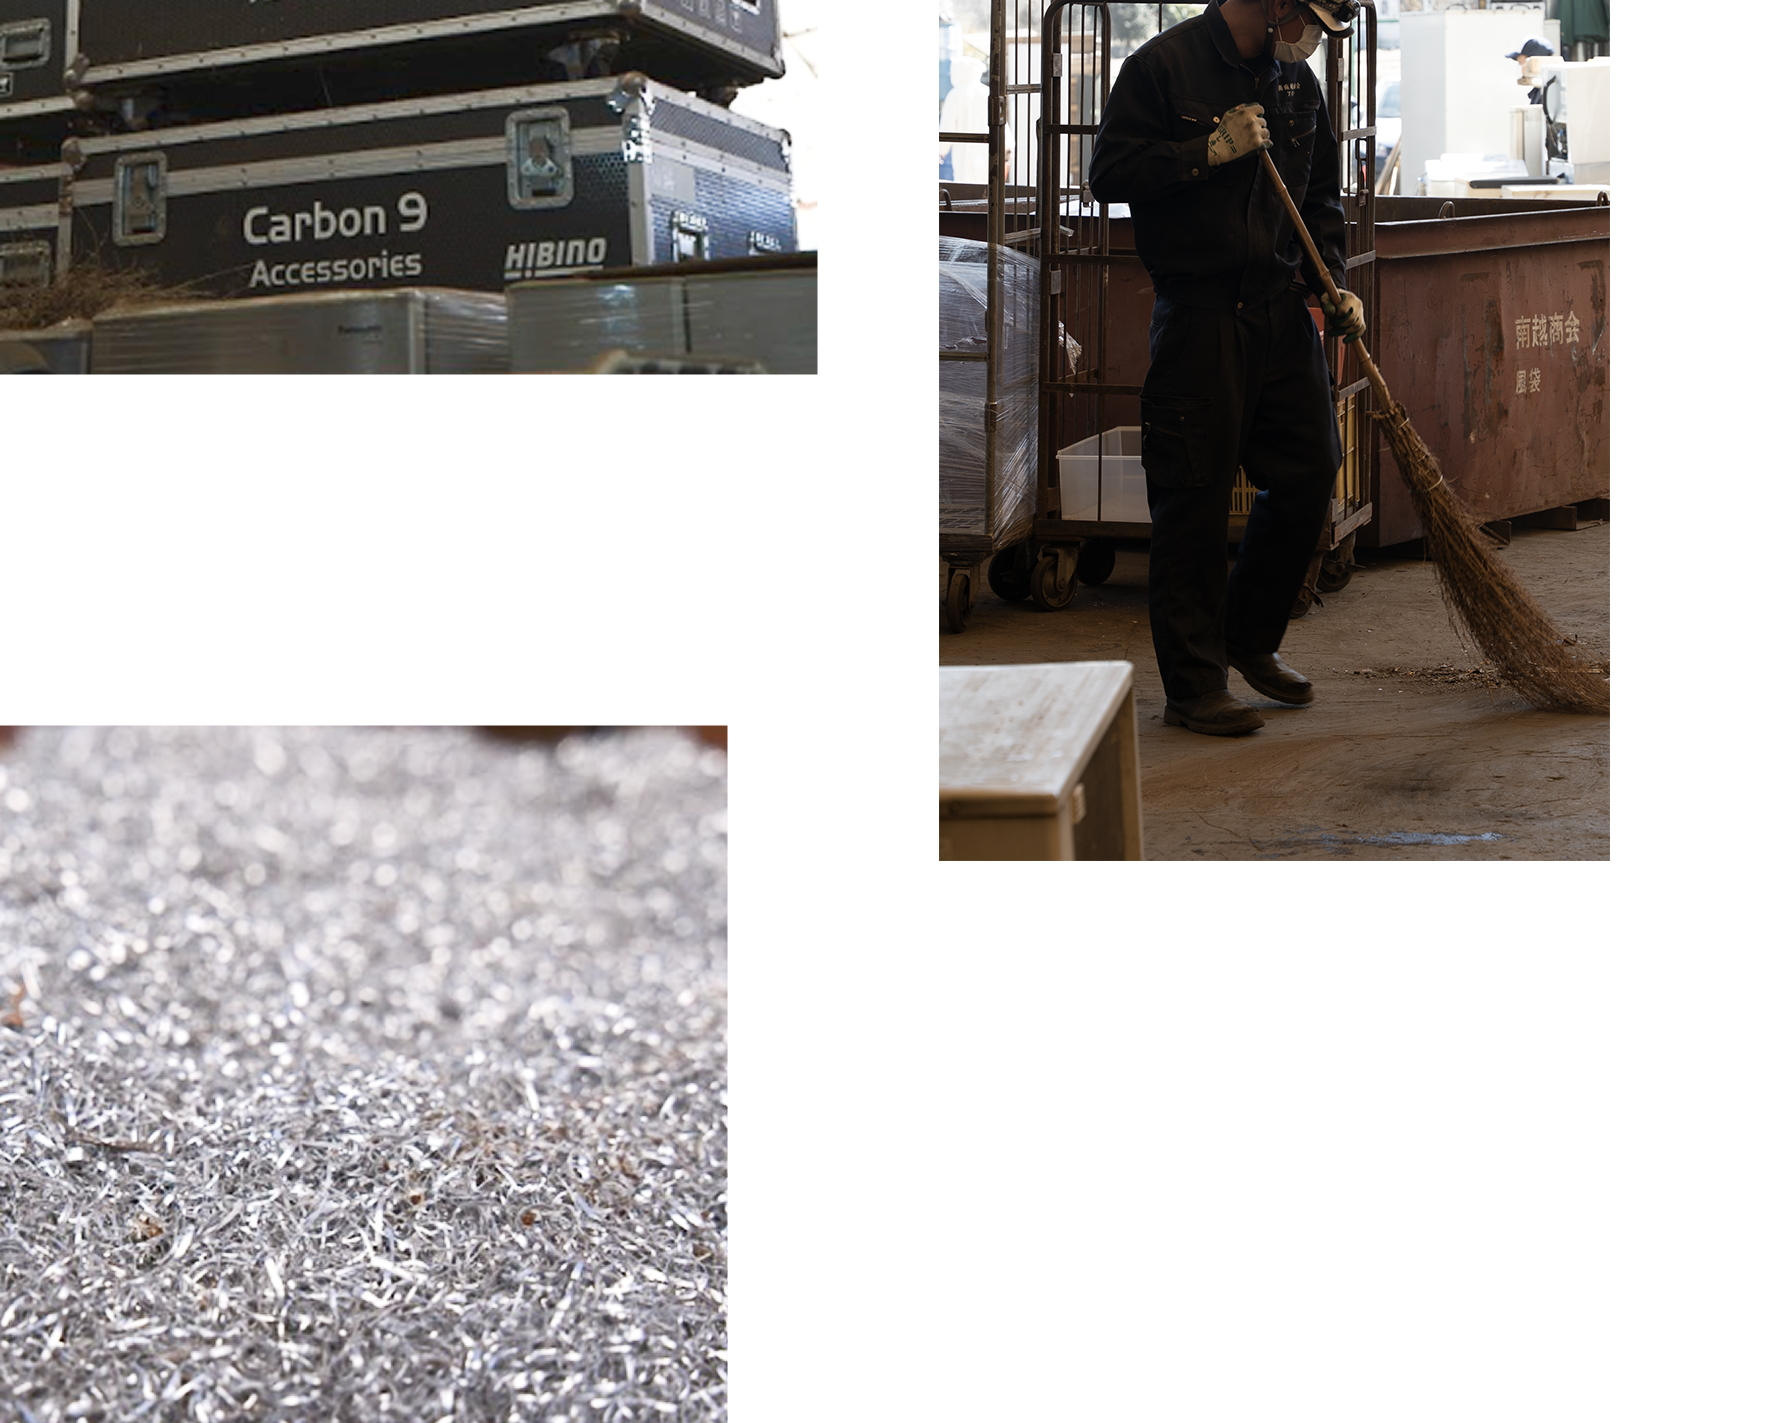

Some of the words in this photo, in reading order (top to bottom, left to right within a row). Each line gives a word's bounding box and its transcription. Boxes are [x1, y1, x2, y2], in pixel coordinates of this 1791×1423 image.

[243, 201, 386, 245] Carbon
[397, 191, 428, 232] 9
[248, 249, 422, 288] Accessories
[504, 237, 607, 278] HIBINO
[1514, 310, 1580, 350] 南越商会
